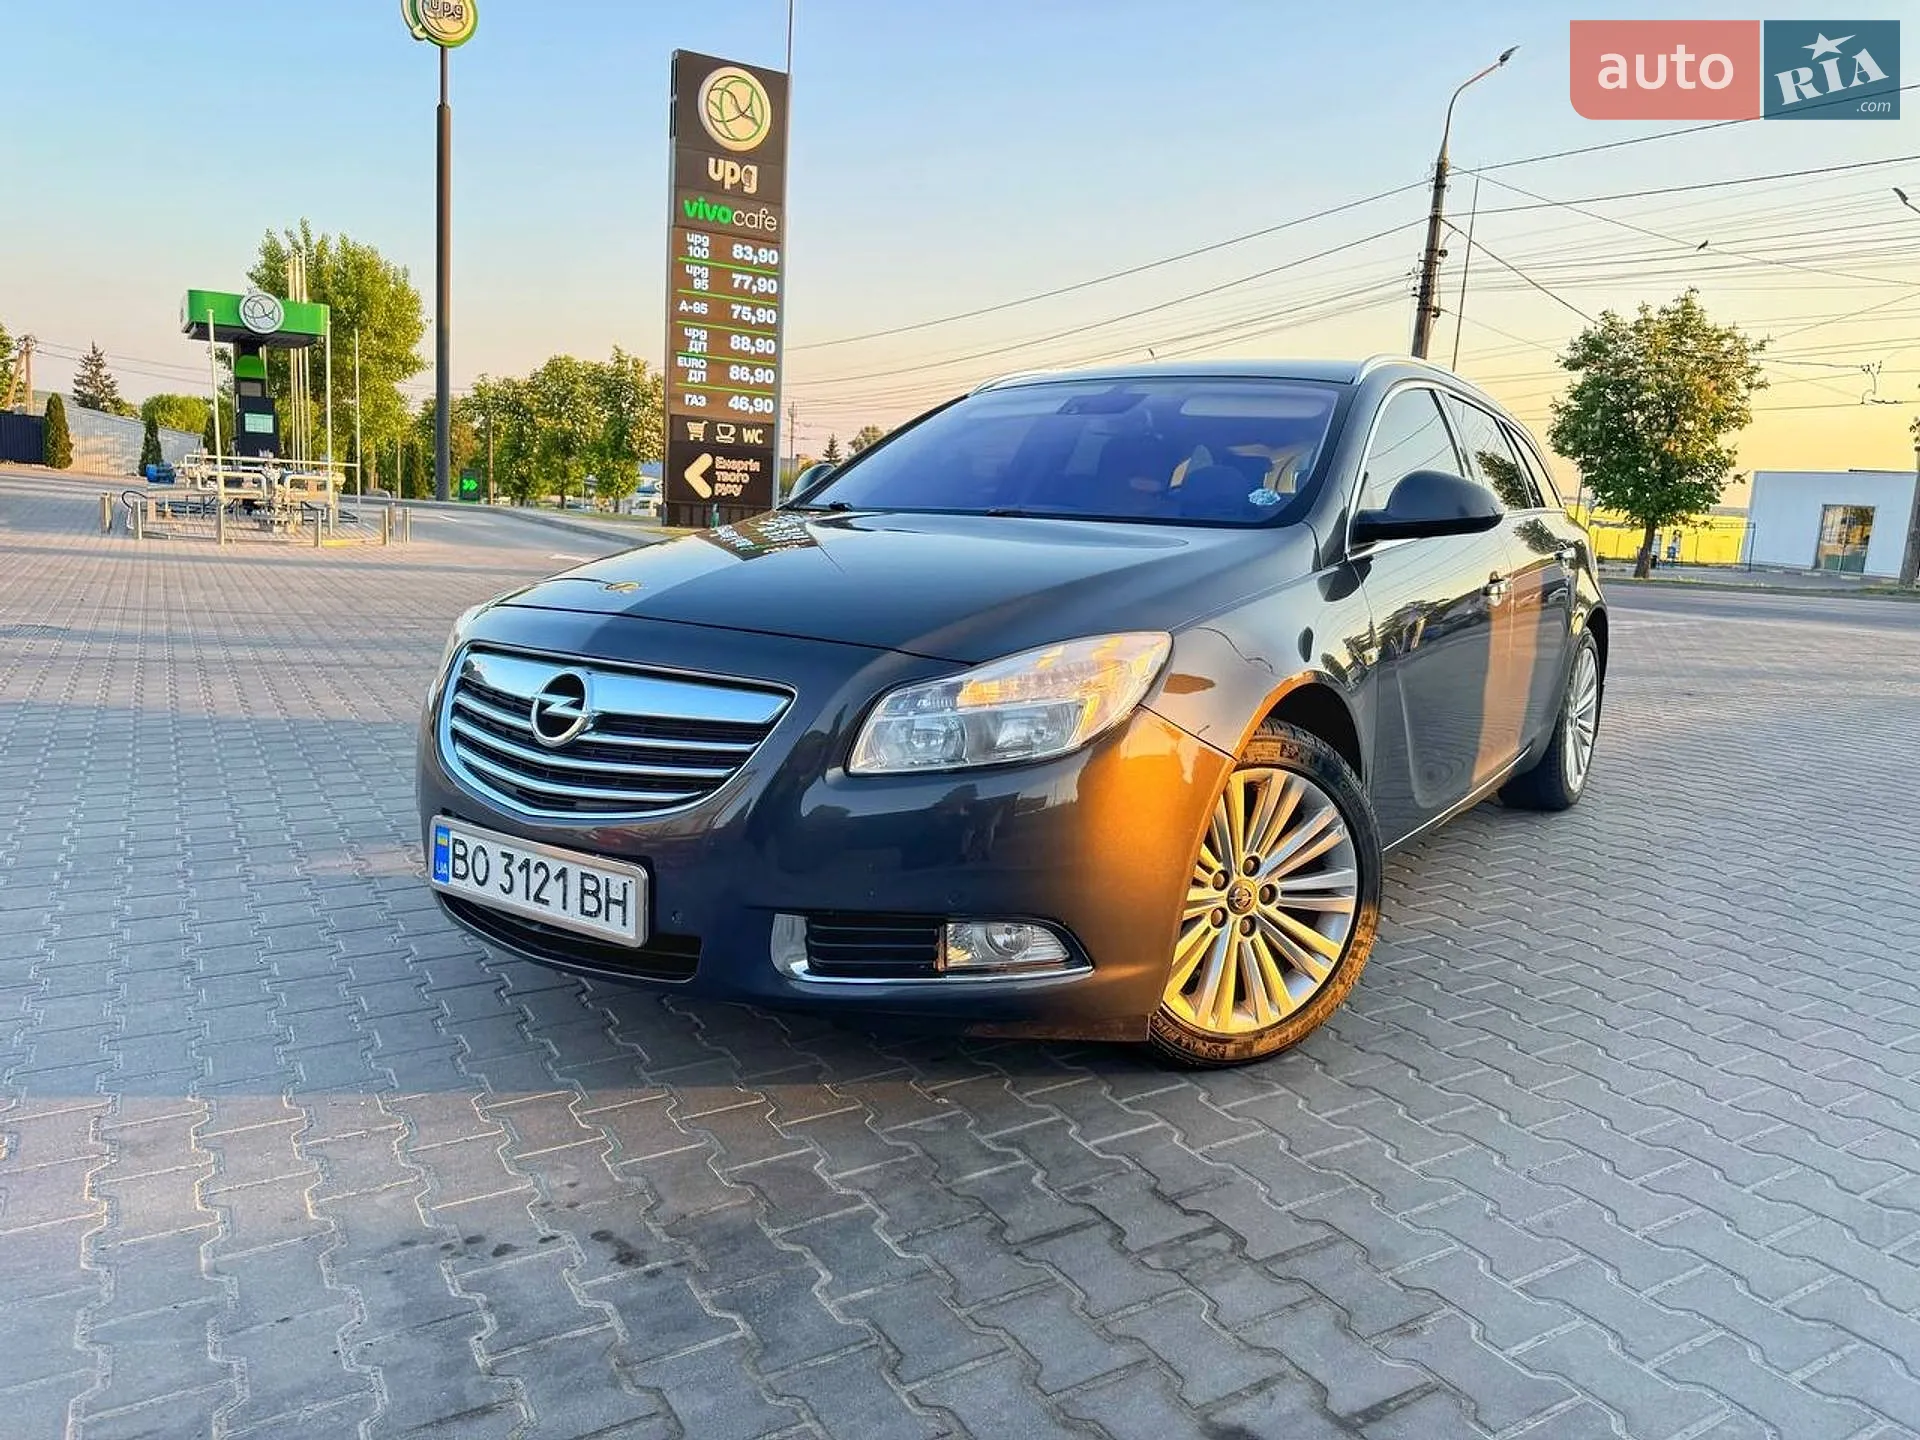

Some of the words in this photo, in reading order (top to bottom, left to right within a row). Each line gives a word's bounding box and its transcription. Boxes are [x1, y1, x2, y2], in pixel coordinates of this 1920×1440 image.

[707, 156, 759, 194] upg
[686, 232, 710, 247] upg
[688, 245, 709, 259] 100
[731, 243, 779, 265] 83,90
[685, 264, 709, 279] upg
[731, 272, 778, 294] 77,90
[730, 303, 777, 325] 75,90
[684, 327, 708, 340] upg
[730, 334, 776, 355] 88,90
[676, 356, 707, 369] EURO
[729, 364, 775, 385] 86,90
[684, 393, 707, 407] ГАЗ
[728, 394, 774, 414] 46,90
[742, 427, 764, 444] WC
[452, 837, 490, 887] BO
[499, 851, 567, 910] 3121
[580, 871, 628, 926] BH
